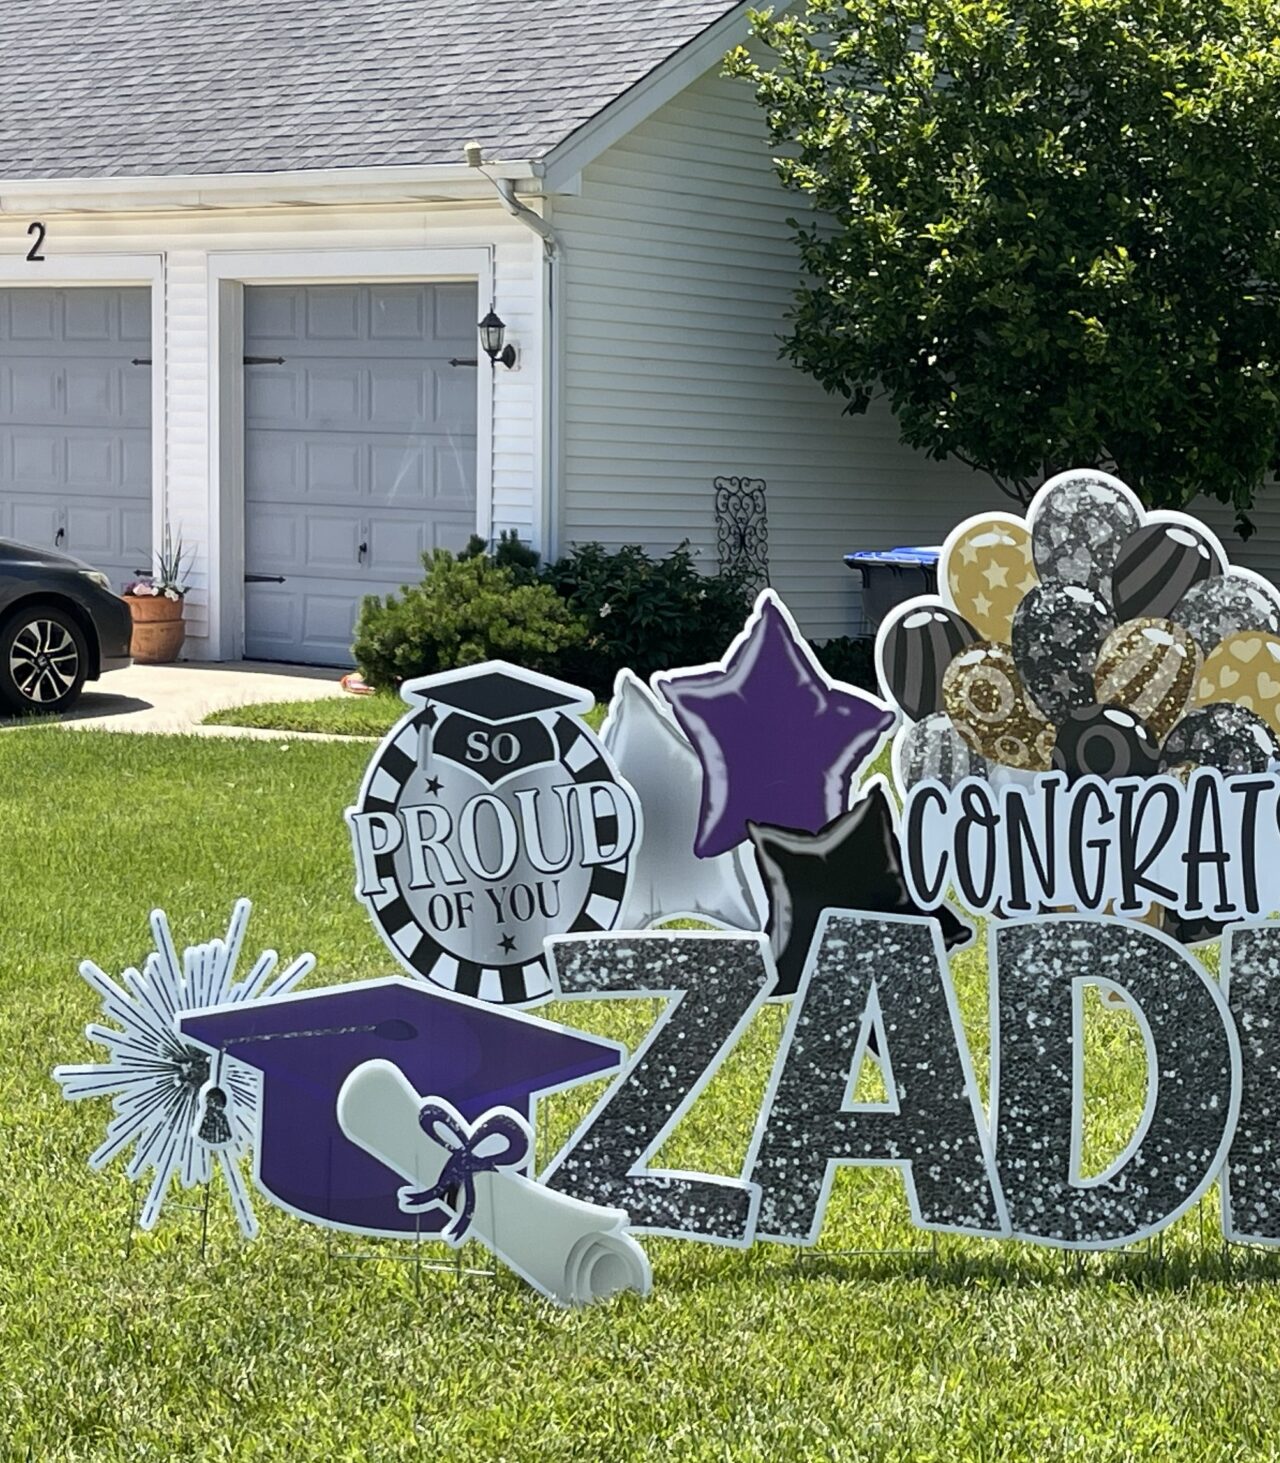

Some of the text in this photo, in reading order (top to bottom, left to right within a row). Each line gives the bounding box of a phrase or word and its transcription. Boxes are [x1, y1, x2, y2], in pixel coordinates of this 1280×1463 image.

[26, 222, 46, 261] 2
[465, 731, 521, 764] SO
[352, 780, 637, 896] PROUD
[428, 879, 561, 931] OF YOU
